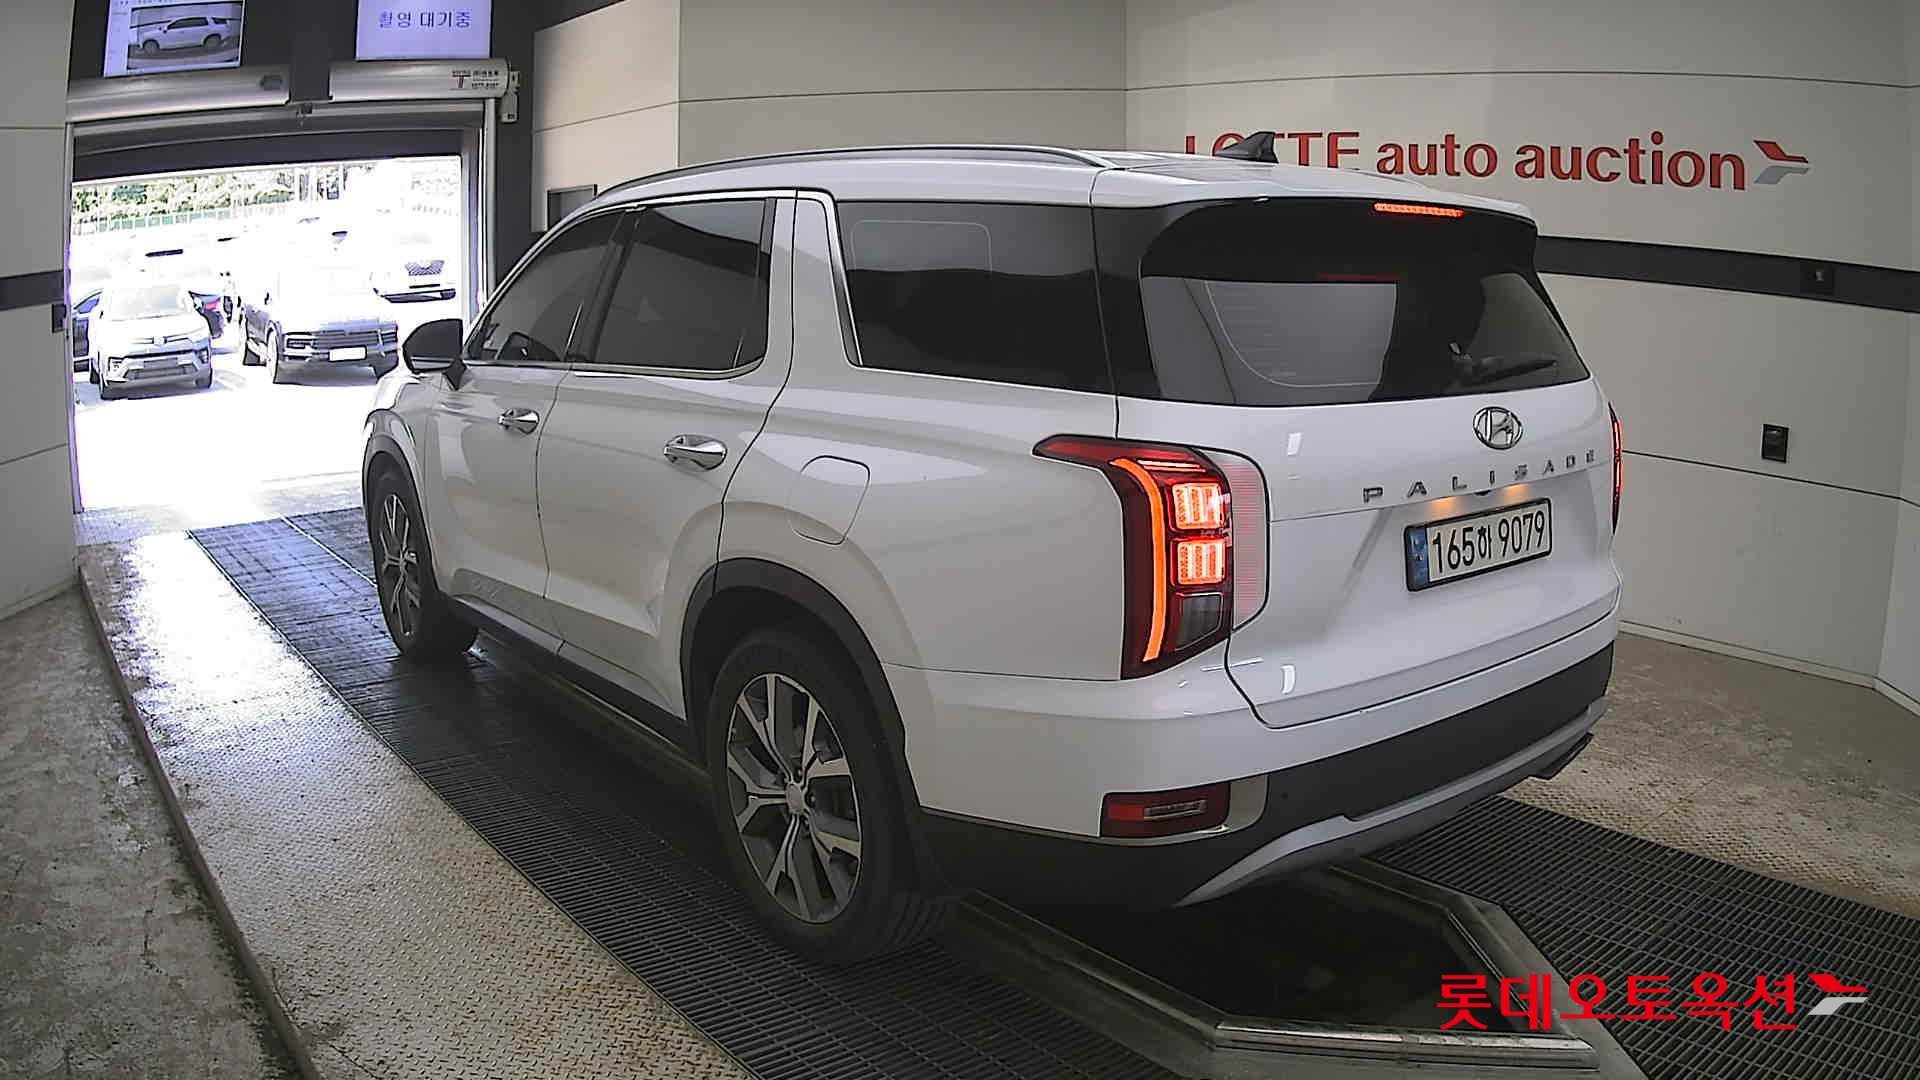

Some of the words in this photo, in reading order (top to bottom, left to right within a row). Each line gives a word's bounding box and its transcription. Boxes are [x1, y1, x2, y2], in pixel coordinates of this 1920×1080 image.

[419, 11, 473, 29] 대기중
[1376, 133, 1499, 178] auto
[1514, 131, 1746, 191] auction
[1362, 449, 1595, 503] PALISADE
[1432, 524, 1493, 574] 165하
[1498, 509, 1545, 558] 9079
